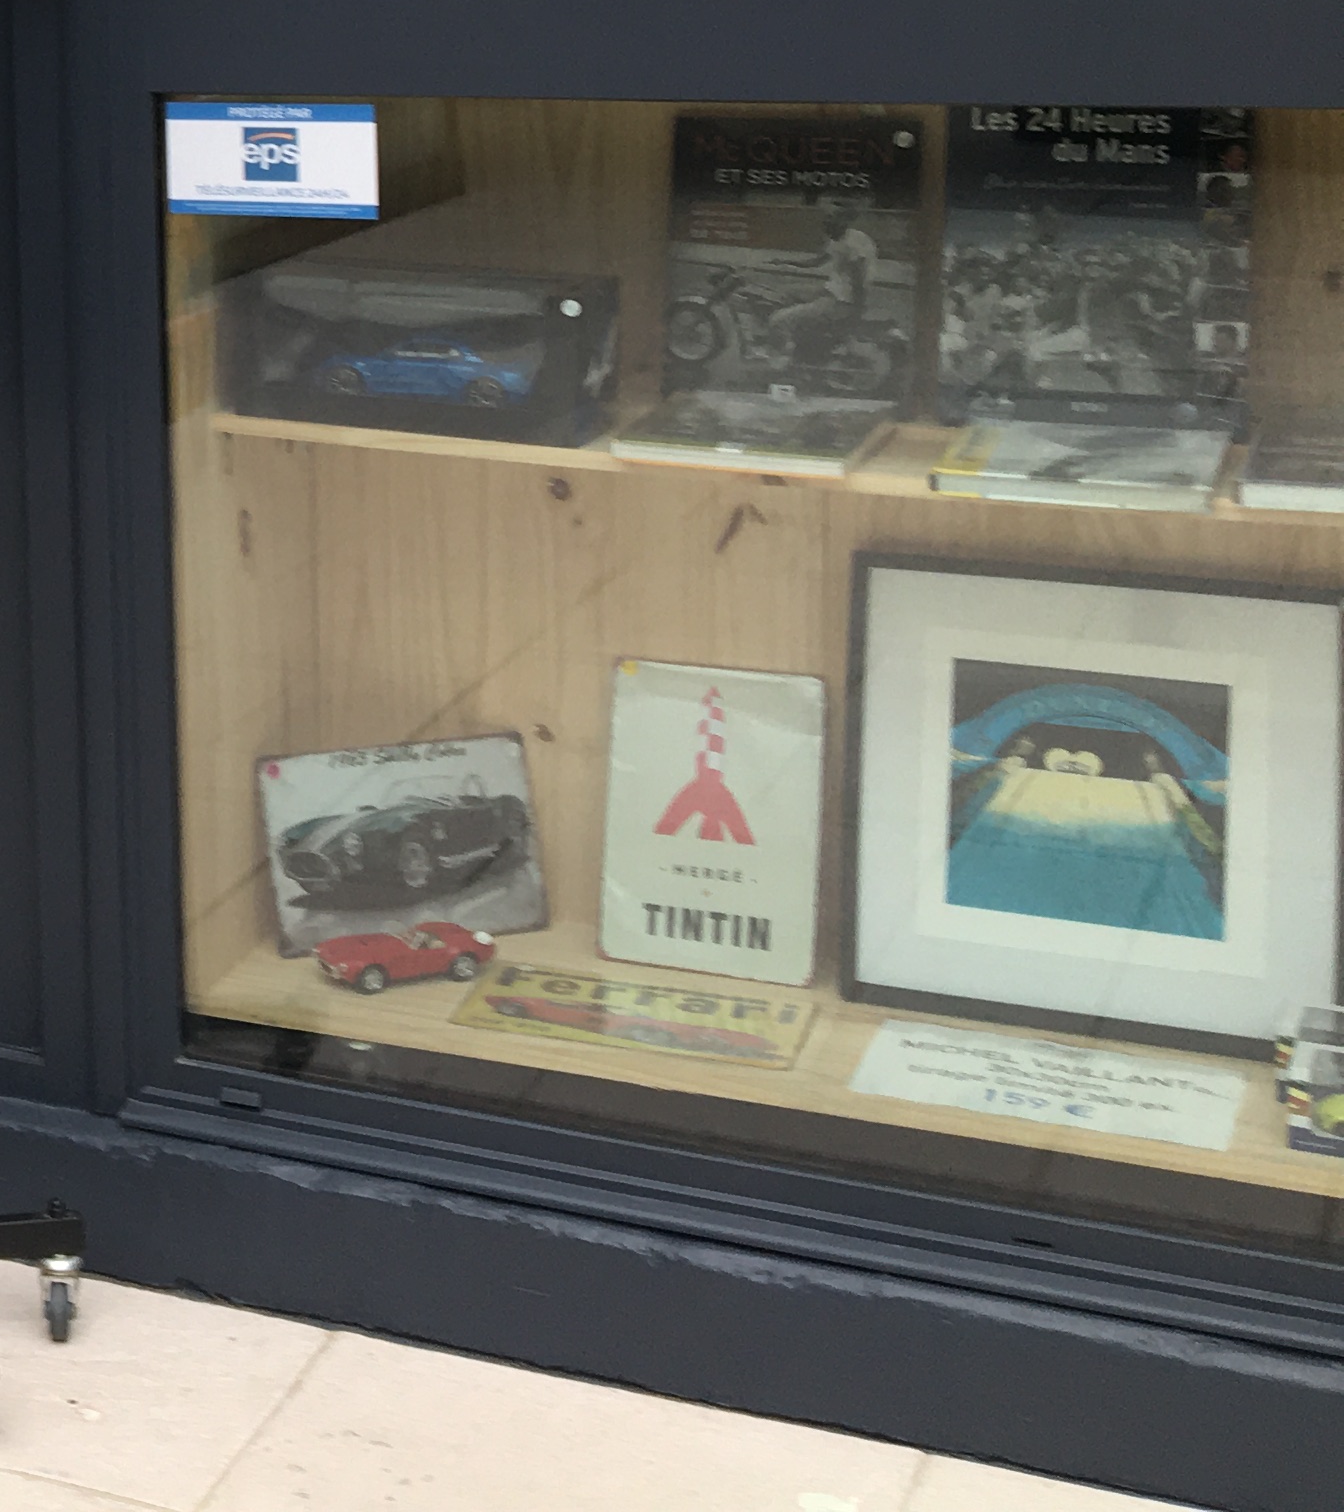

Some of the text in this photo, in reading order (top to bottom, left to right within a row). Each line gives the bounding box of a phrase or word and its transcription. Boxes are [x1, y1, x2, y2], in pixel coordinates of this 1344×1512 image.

[286, 107, 312, 119] PAR
[970, 106, 1171, 134] Les 24 Heures
[243, 142, 301, 170] eps
[1051, 138, 1171, 164] du Mans
[715, 168, 870, 188] ET SES MOTOS
[641, 901, 773, 952] TINTIN
[496, 965, 799, 1024] Ferrari
